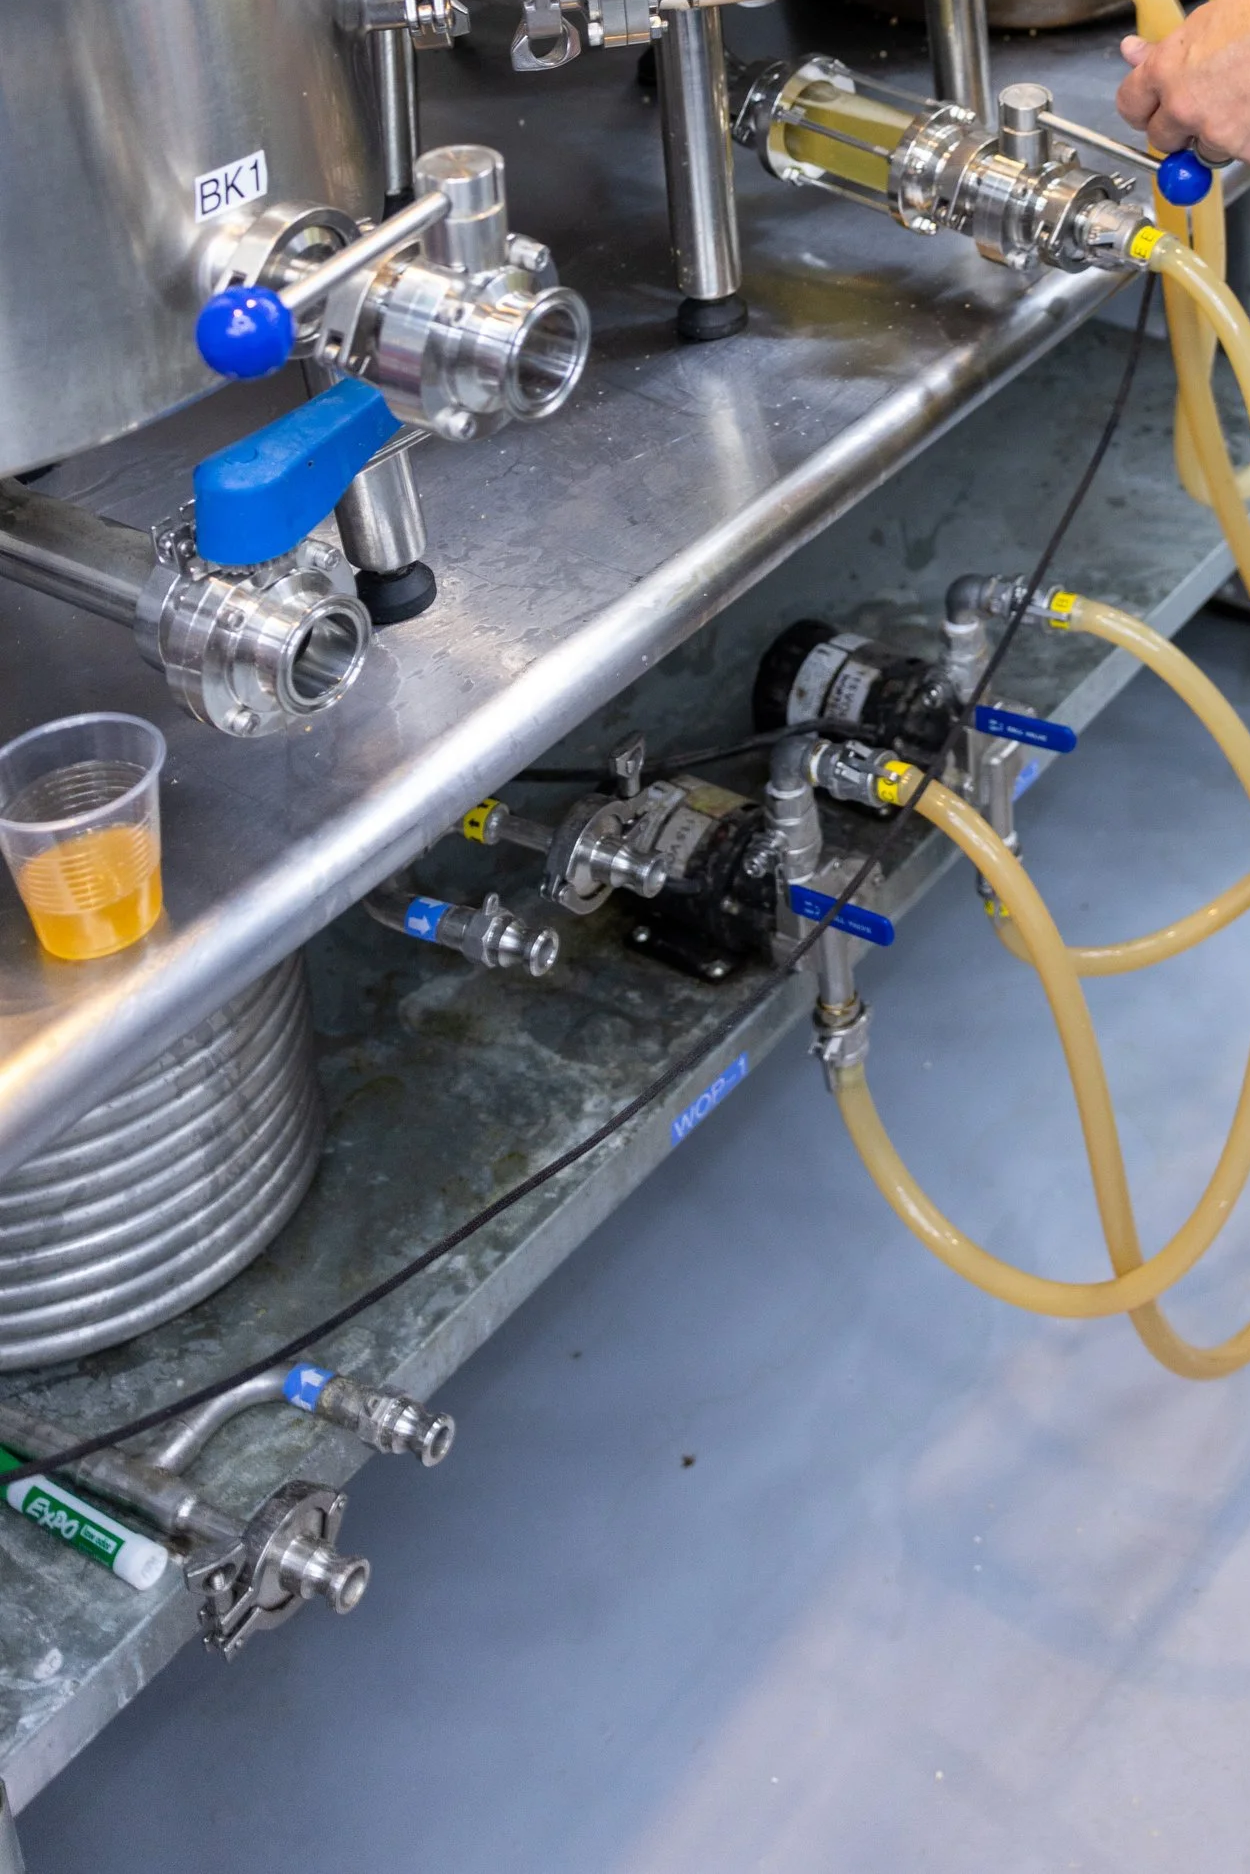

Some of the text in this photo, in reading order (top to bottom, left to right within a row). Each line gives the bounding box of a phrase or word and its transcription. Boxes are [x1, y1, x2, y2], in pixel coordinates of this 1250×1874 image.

[200, 159, 260, 216] BK1
[674, 1057, 746, 1138] WOP-1
[26, 1497, 80, 1540] EXPO
